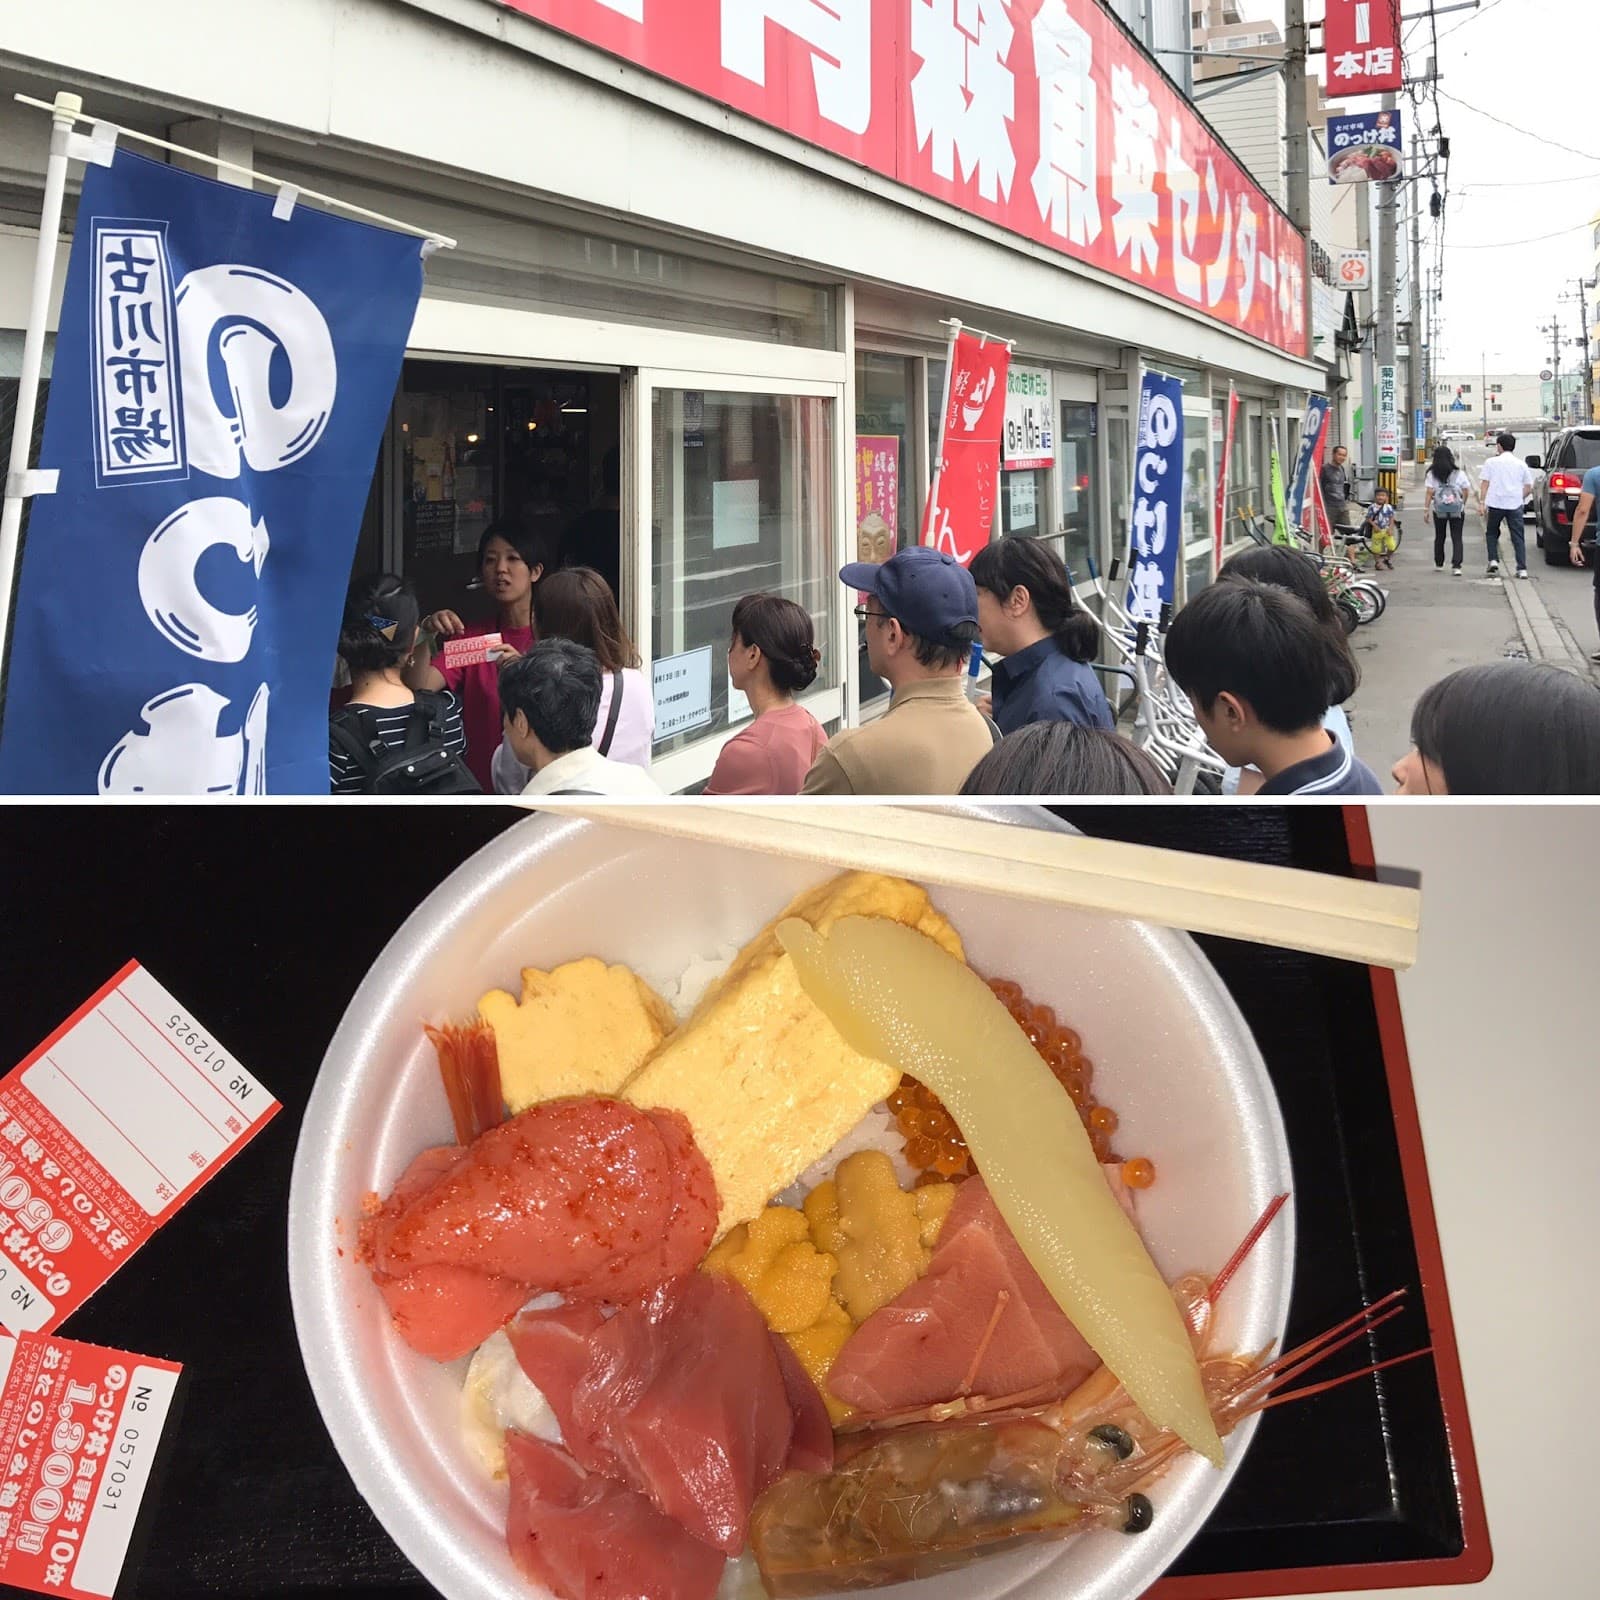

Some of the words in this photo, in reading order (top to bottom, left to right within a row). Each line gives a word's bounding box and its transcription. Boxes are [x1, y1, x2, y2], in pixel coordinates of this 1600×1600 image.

[1333, 47, 1394, 79] 本店
[1333, 126, 1396, 147] のっけ丼
[1381, 368, 1394, 412] 菊池内科
[976, 460, 991, 529] いいとこ
[167, 1015, 225, 1072] 012925
[224, 1115, 243, 1135] 電話
[188, 1150, 207, 1169] 住所
[155, 1182, 174, 1202] 氏名
[0, 1345, 63, 1557] おたのしみ抽選
[15, 1379, 97, 1555] 1,300円
[103, 1429, 139, 1511] 057031
